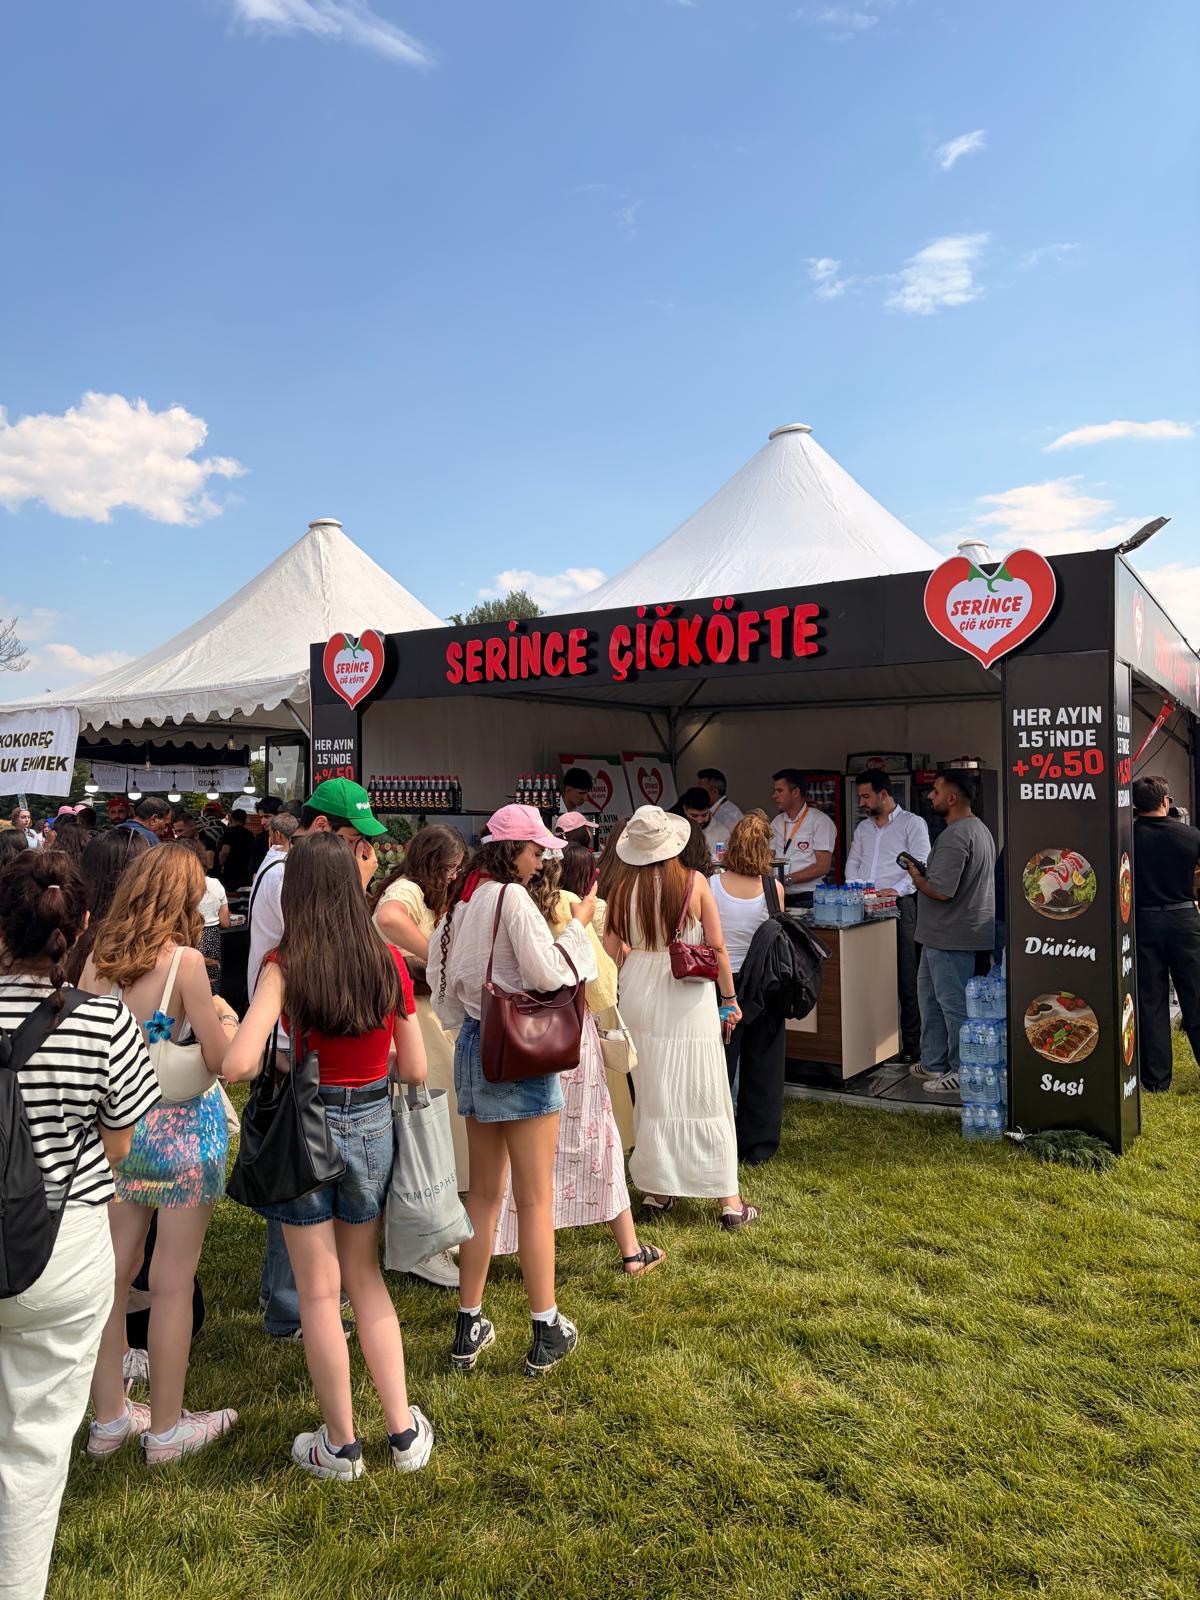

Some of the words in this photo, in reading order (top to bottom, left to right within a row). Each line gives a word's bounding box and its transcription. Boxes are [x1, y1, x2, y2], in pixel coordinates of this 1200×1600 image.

[950, 595, 1023, 616] SERİNCE
[959, 617, 976, 632] ÇİĞ
[979, 616, 1013, 631] KÖFTE
[446, 620, 588, 685] SERİNCE
[608, 596, 821, 682] ÇİĞKÖFTE
[336, 660, 370, 674] SERİNCE
[1012, 708, 1051, 727] HER
[1055, 706, 1102, 725] AYIN
[314, 739, 332, 751] HER
[333, 738, 354, 751] AYIN
[0, 758, 19, 773] UK
[1012, 749, 1104, 780] +%50
[1020, 783, 1097, 800] BEDAVA
[1024, 936, 1096, 962] Dürüm
[1040, 1073, 1084, 1096] Susi
